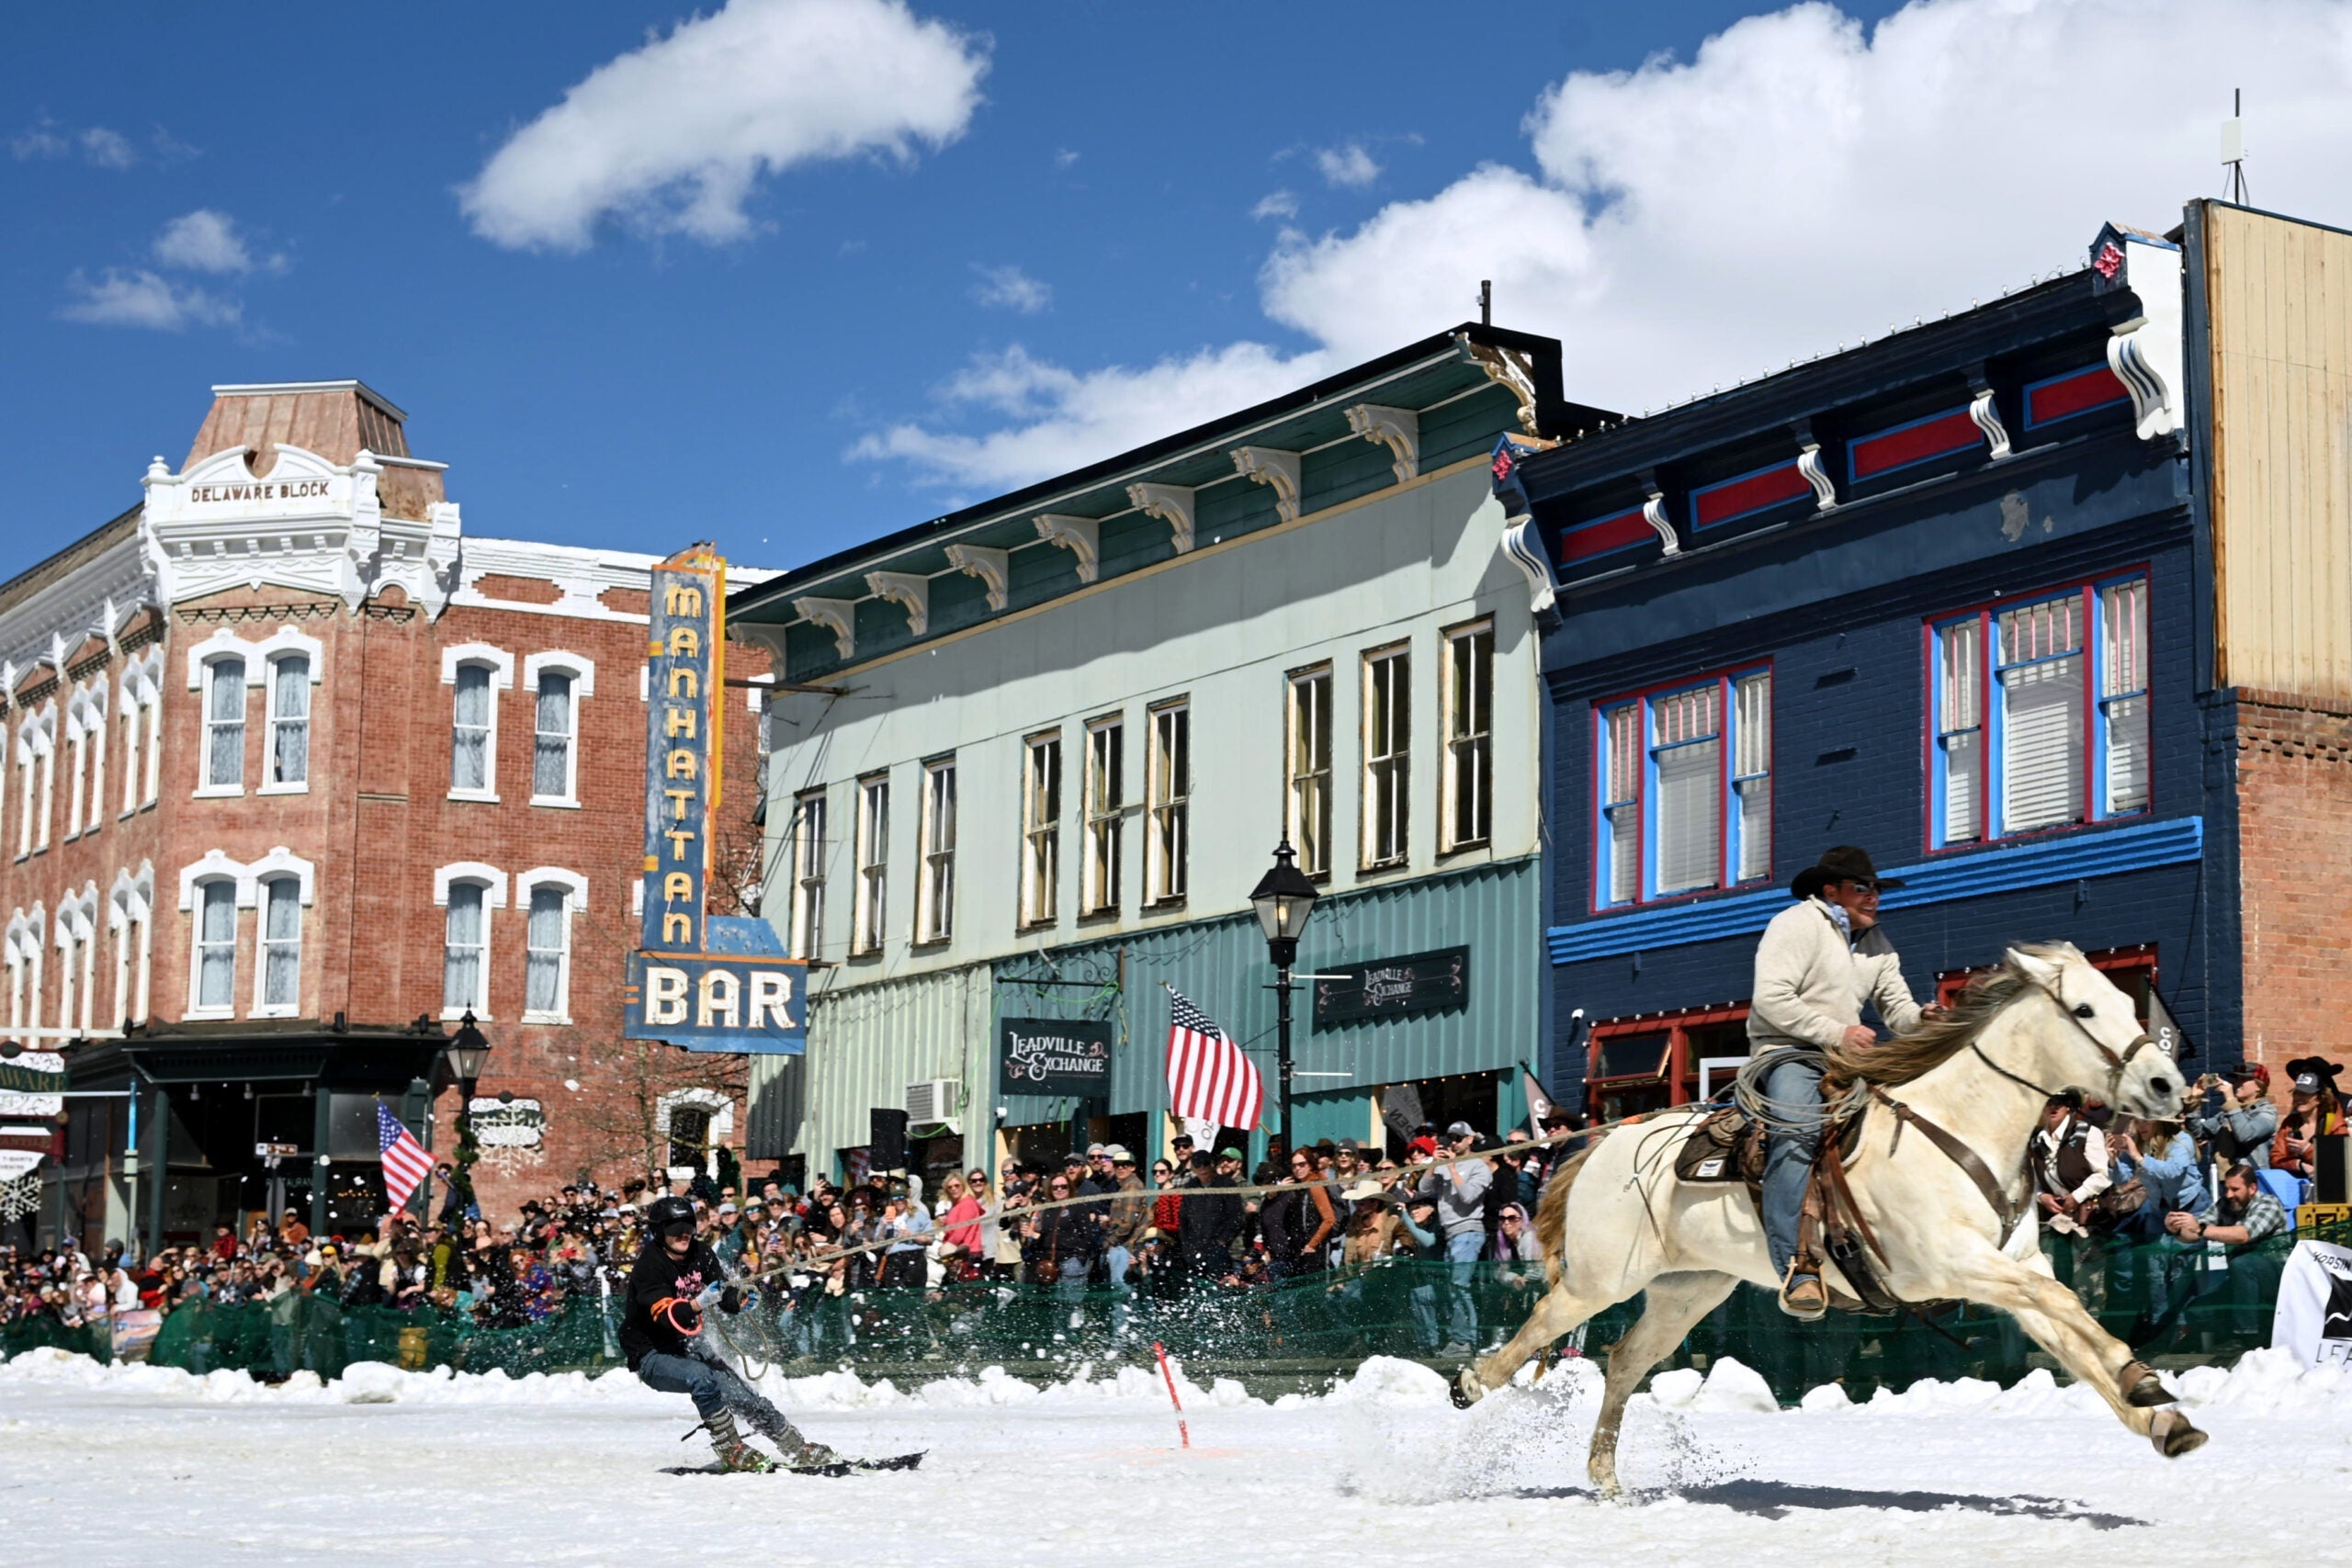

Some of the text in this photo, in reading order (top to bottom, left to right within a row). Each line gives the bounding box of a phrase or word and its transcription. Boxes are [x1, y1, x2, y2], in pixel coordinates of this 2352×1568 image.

[191, 481, 330, 502] DELAWARE BLOCK
[1363, 967, 1404, 994] LEADVILLE
[1373, 980, 1413, 1007] EXCHANGE
[643, 965, 797, 1030] BAR
[1009, 1031, 1086, 1064] LEADVILLE
[1028, 1052, 1104, 1081] EXCHANGE
